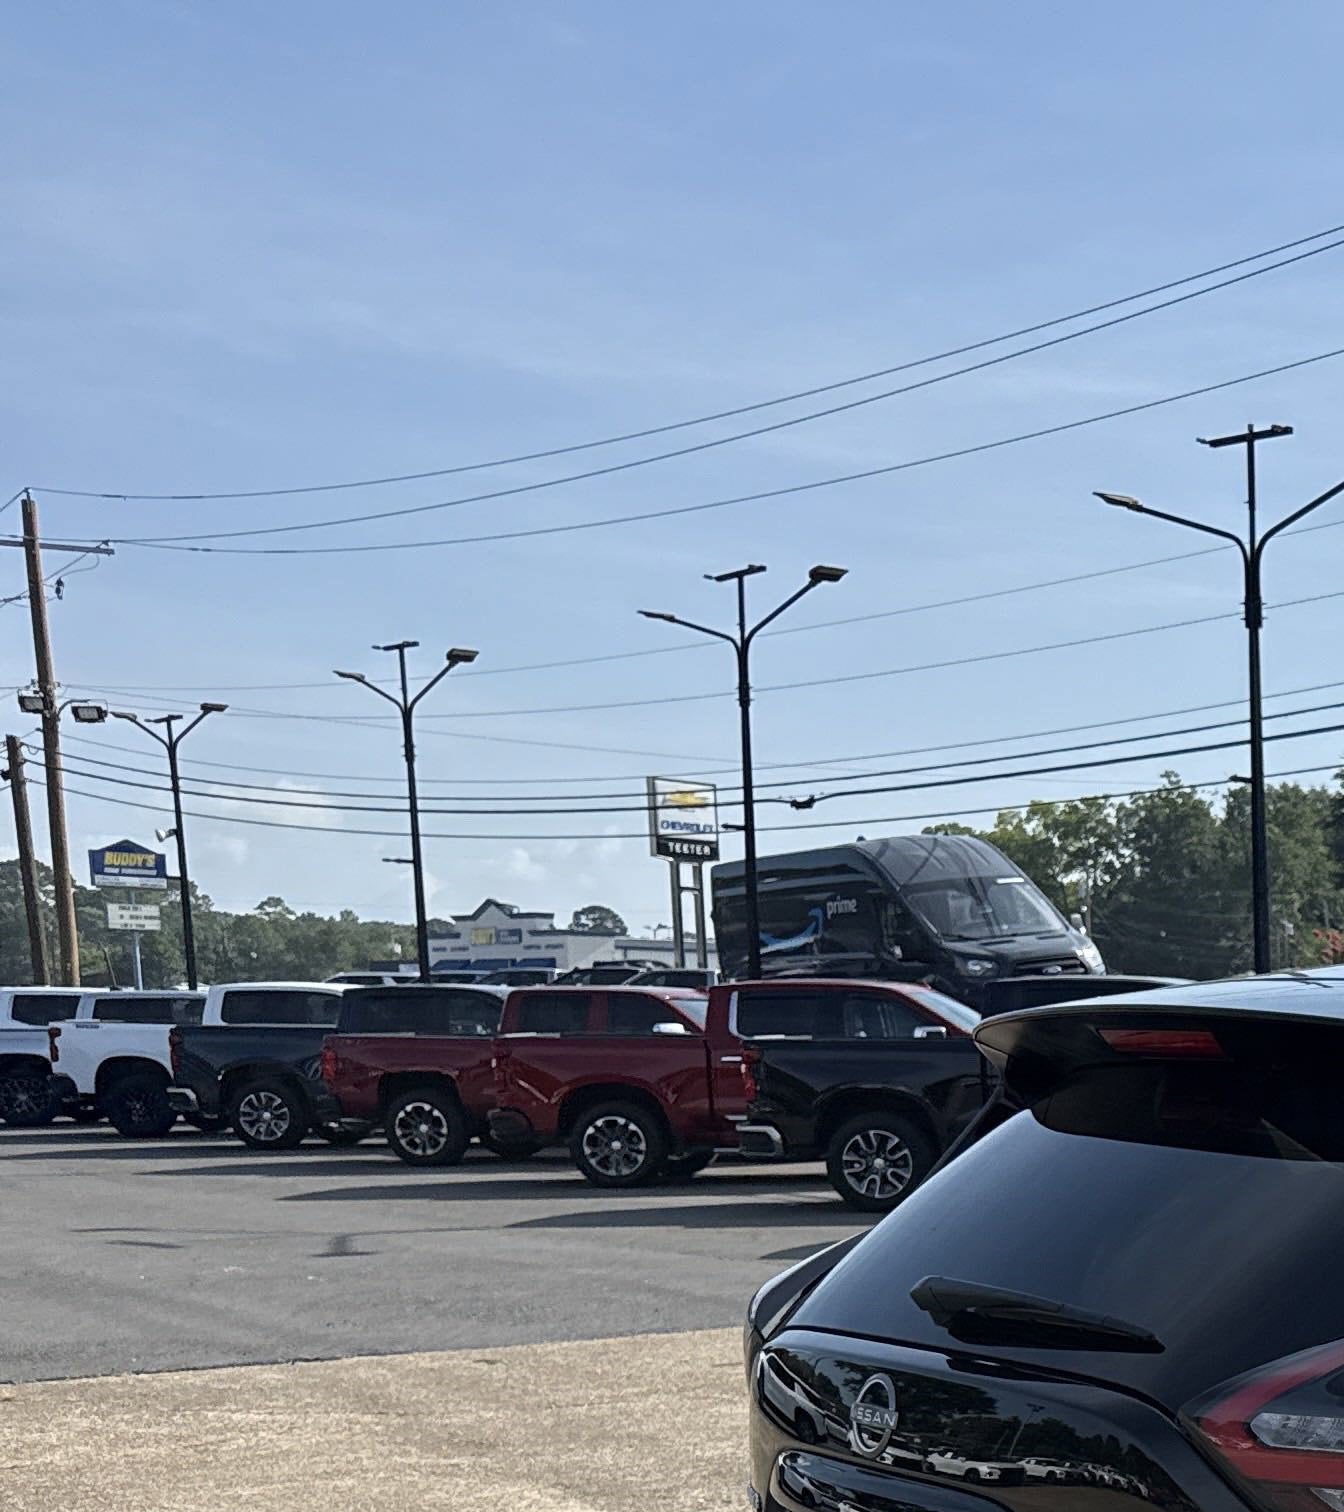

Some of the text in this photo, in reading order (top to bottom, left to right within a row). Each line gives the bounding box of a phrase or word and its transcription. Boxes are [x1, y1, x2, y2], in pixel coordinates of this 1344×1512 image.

[668, 841, 711, 856] TEETER
[104, 851, 156, 868] BUDDY'S
[826, 895, 857, 920] prime
